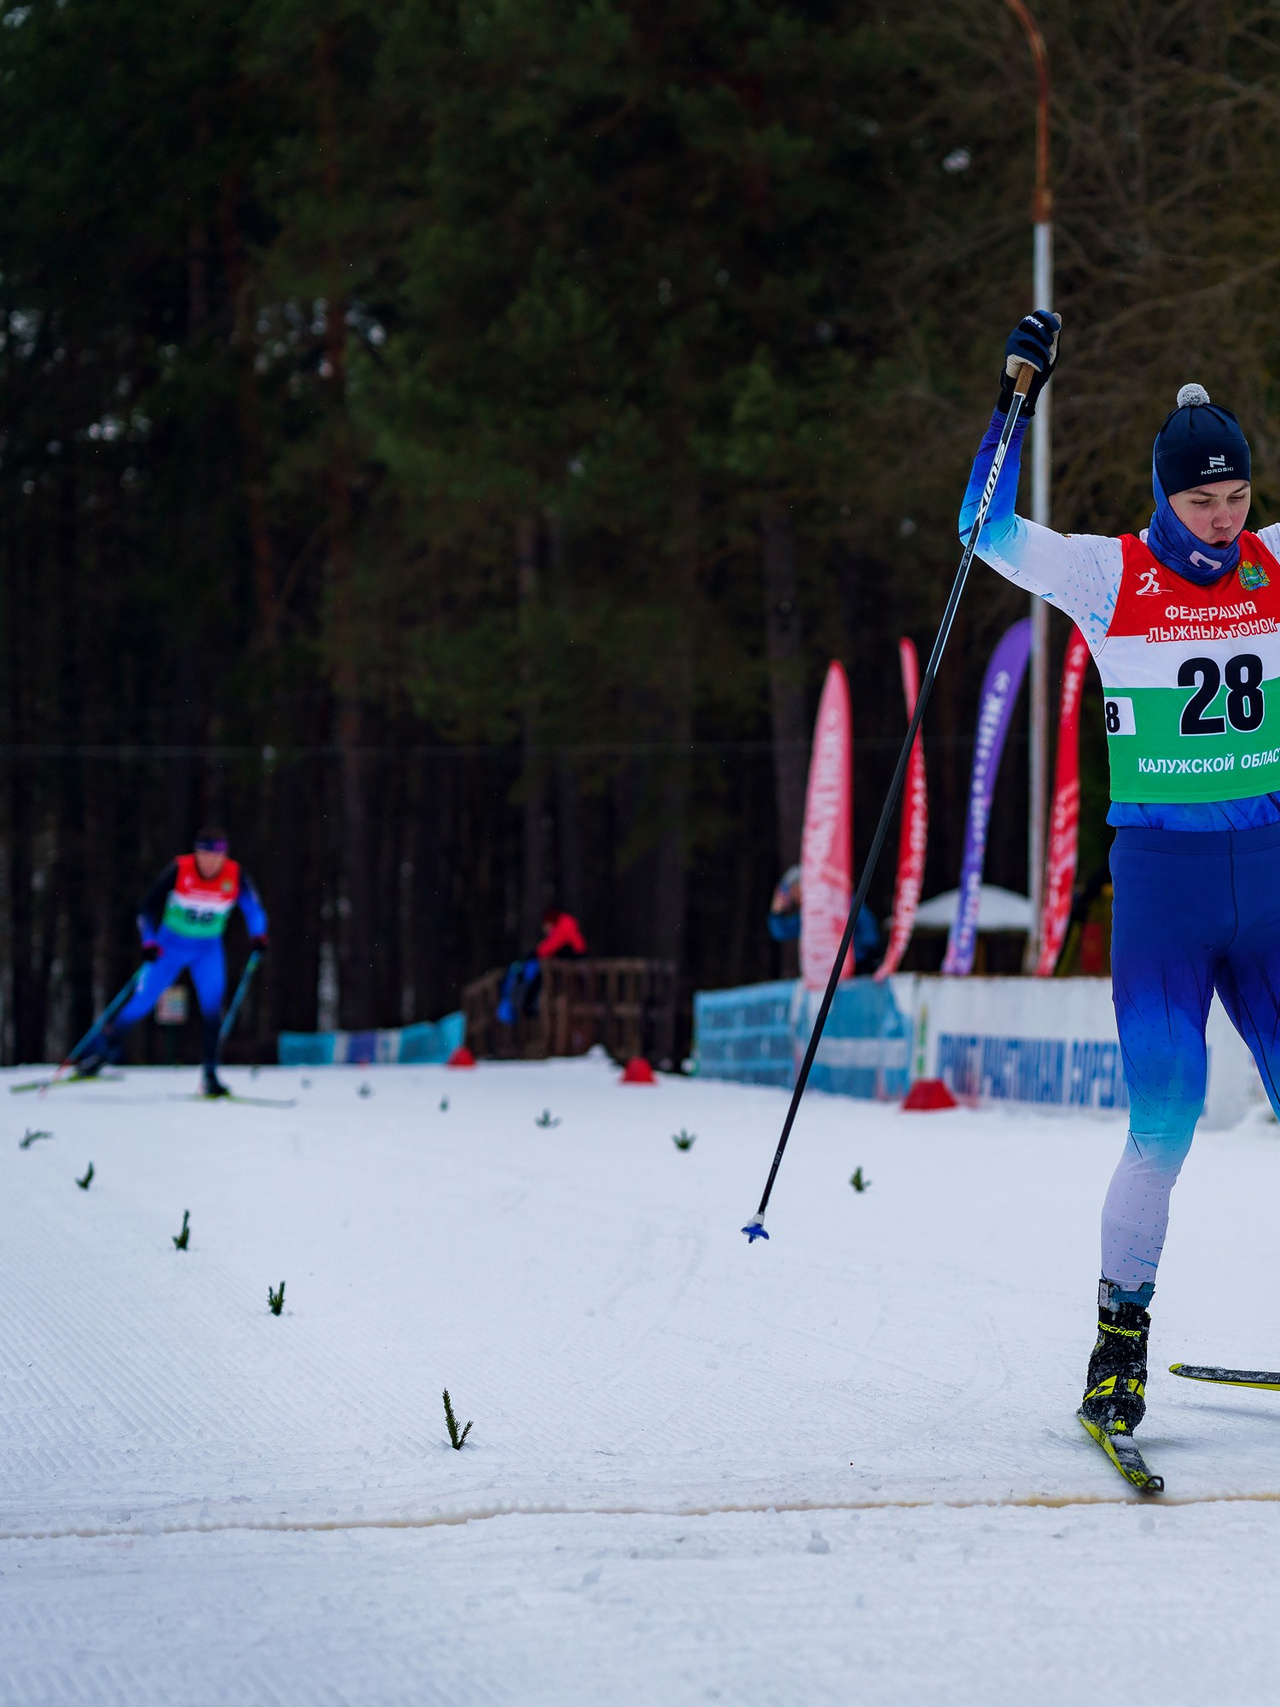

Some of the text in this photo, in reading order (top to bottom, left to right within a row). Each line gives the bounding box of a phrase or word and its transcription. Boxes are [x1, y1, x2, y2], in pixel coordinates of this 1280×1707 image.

[1201, 467, 1234, 476] NORDSKI
[1165, 601, 1257, 622] ФЕДЕРАЦИЯ
[1147, 617, 1279, 643] ЛЫЖНЫХ ГОНОК
[1177, 653, 1265, 736] 28
[1138, 753, 1234, 774] КАЛУЖСКОЙ
